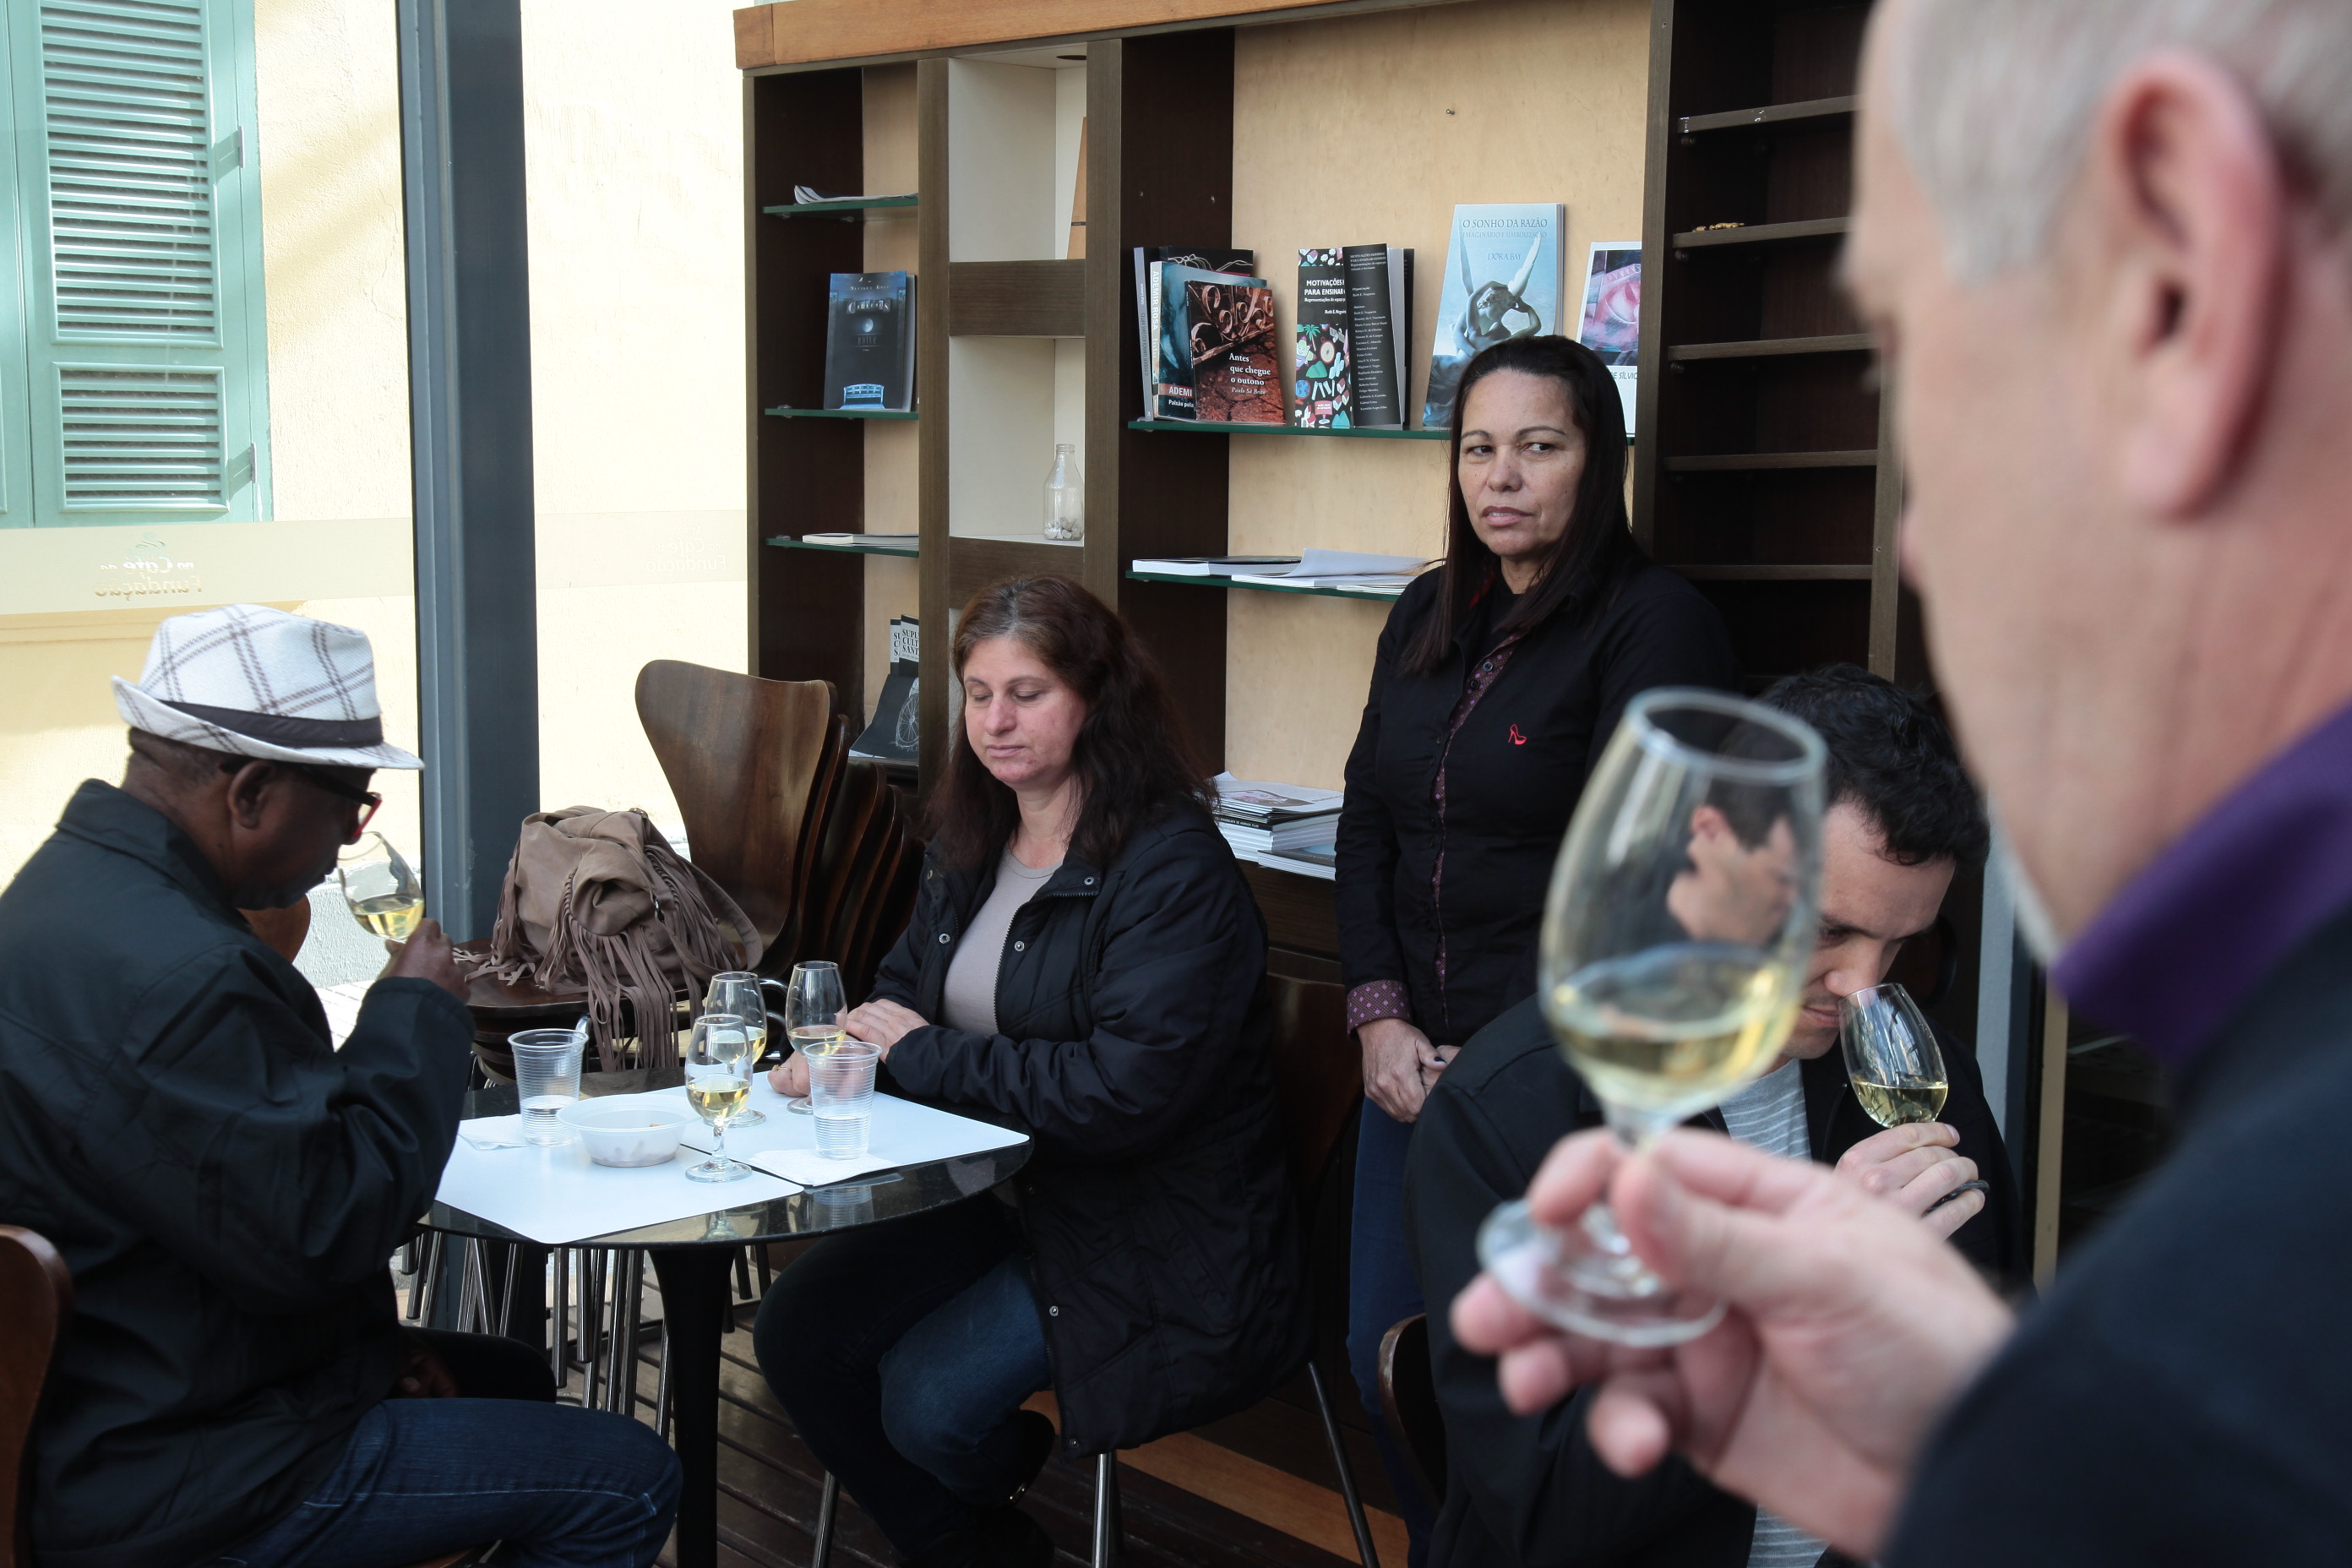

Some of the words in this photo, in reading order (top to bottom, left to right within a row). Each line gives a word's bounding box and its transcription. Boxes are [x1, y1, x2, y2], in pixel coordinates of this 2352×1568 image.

[1462, 219, 1470, 228] O
[1473, 219, 1504, 228] SONHO
[1506, 219, 1518, 228] DA
[1520, 217, 1548, 228] RAZÃO
[1306, 278, 1342, 287] MOTIVAÇÕES
[1229, 353, 1249, 362] Antes
[1245, 365, 1271, 377] chegue
[1237, 377, 1264, 385] outono
